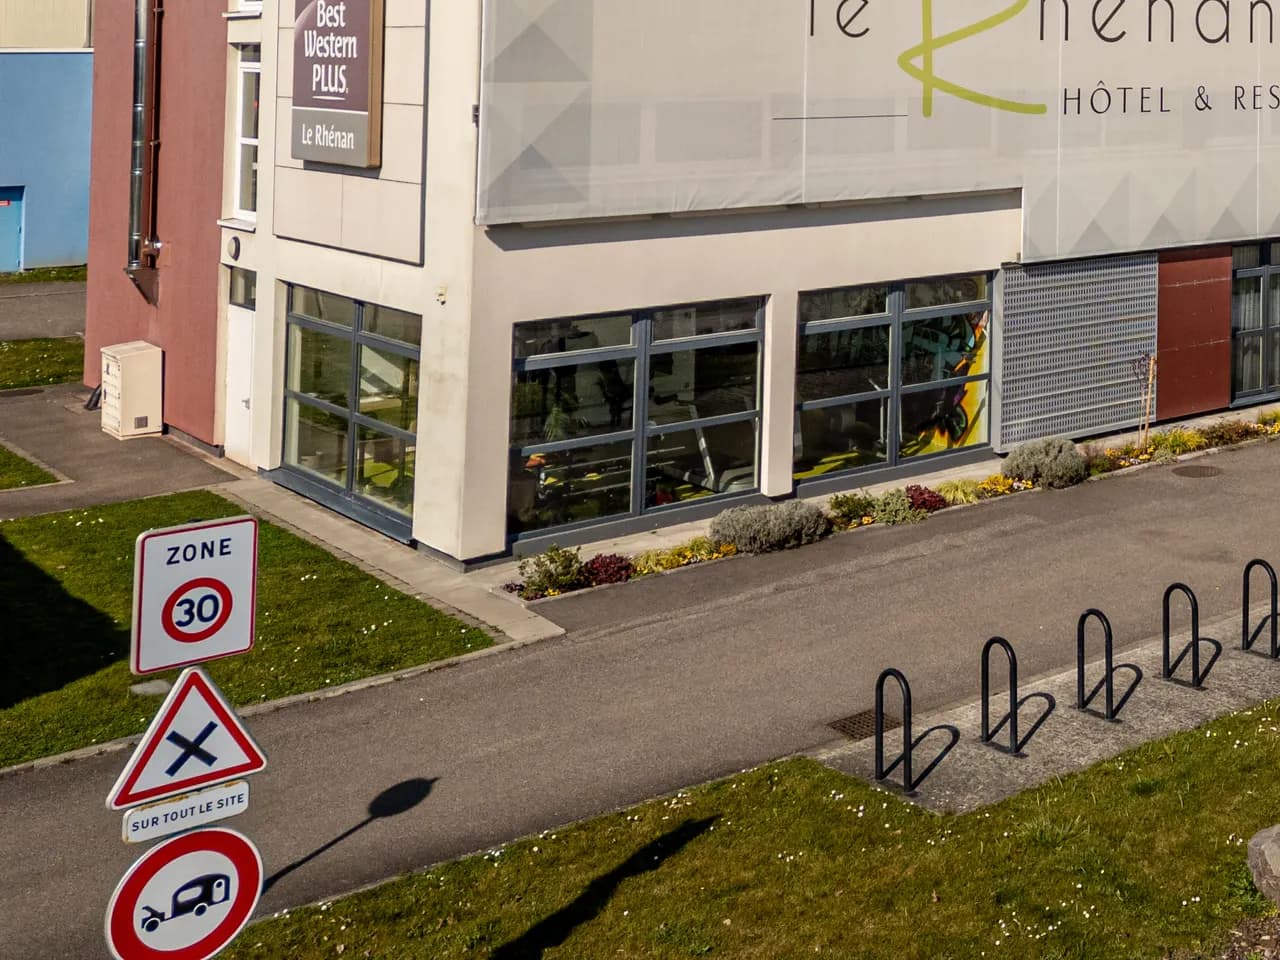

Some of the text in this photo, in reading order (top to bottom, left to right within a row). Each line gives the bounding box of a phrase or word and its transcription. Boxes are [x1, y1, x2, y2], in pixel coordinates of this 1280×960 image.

[316, 0, 346, 28] Best
[303, 30, 358, 59] Western
[312, 63, 347, 93] PLUS
[1063, 80, 1171, 116] HÔTEL
[1193, 84, 1213, 112] &
[301, 122, 355, 150] Le Rhénan
[166, 537, 232, 566] ZONE
[174, 593, 220, 628] 30
[131, 793, 245, 832] SUR TOUT LE SITE
